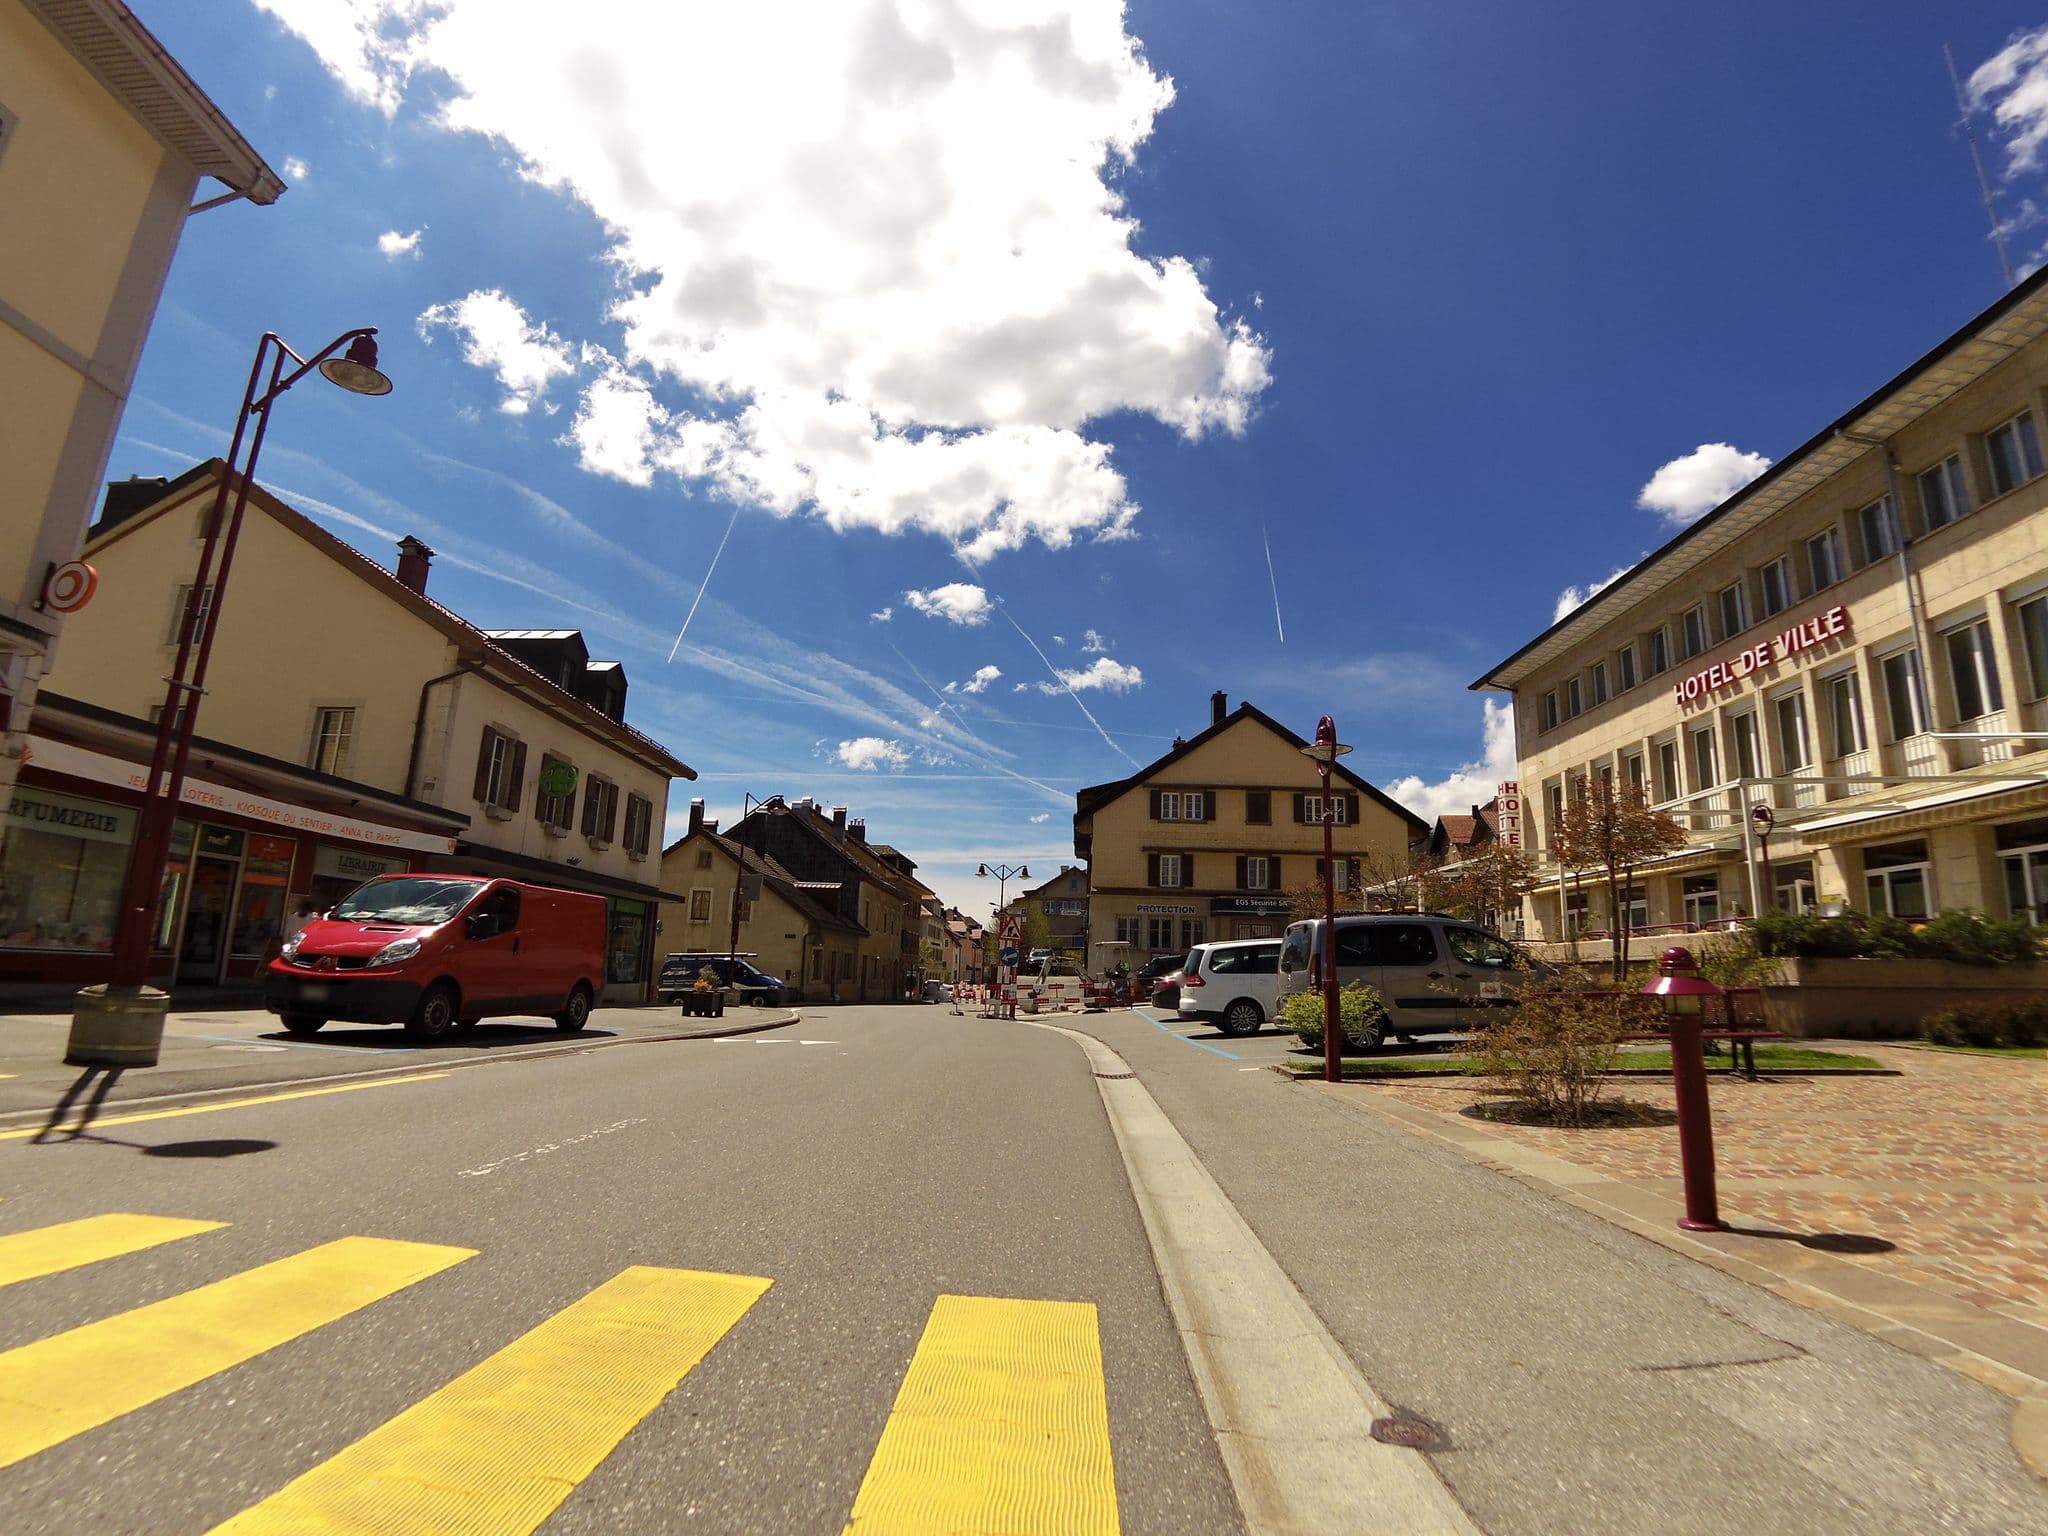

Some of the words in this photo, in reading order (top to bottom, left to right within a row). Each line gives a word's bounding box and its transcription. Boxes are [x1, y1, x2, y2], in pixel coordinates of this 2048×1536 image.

[1673, 662, 1735, 705] HOTEL
[1740, 642, 1771, 674] DE
[1776, 606, 1847, 656] VILLE
[10, 797, 118, 833] RFUMERIE
[236, 801, 280, 820] KIOSQUE
[283, 813, 296, 825] DU
[299, 817, 333, 832] SENTIER
[340, 826, 362, 838] ANNA
[364, 830, 374, 840] ET
[1505, 782, 1520, 850] HOTE
[1136, 905, 1195, 914] PROTECTION
[1250, 898, 1277, 906] Sécurité
